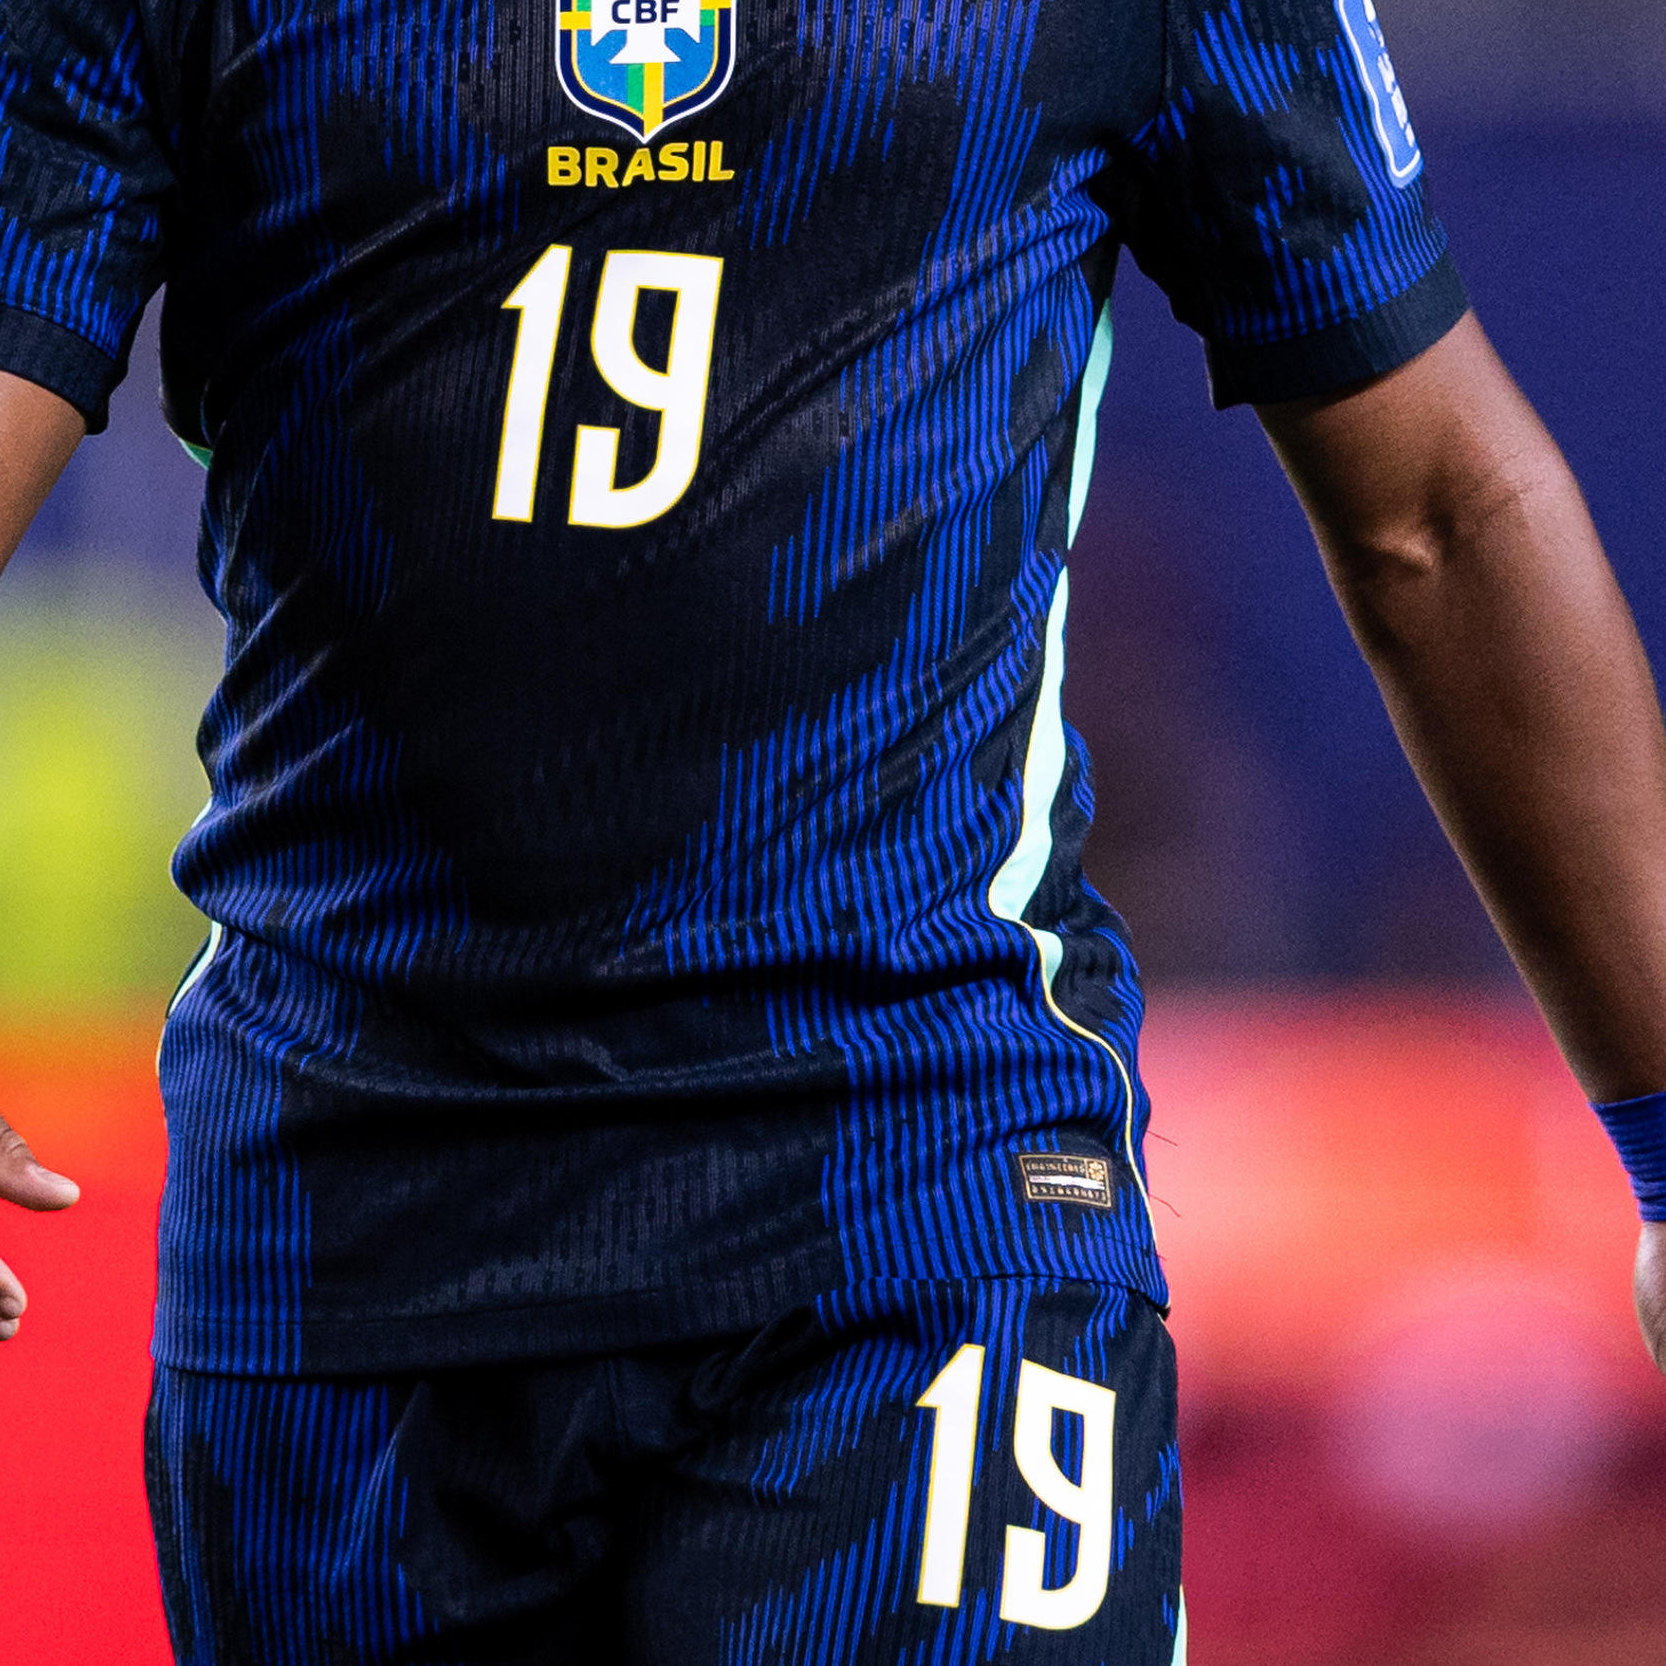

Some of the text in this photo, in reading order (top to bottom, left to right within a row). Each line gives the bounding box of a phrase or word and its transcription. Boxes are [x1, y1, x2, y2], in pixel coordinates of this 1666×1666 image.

[547, 141, 735, 189] BRASIL
[492, 243, 724, 530] 19
[915, 1343, 1117, 1630] 19
